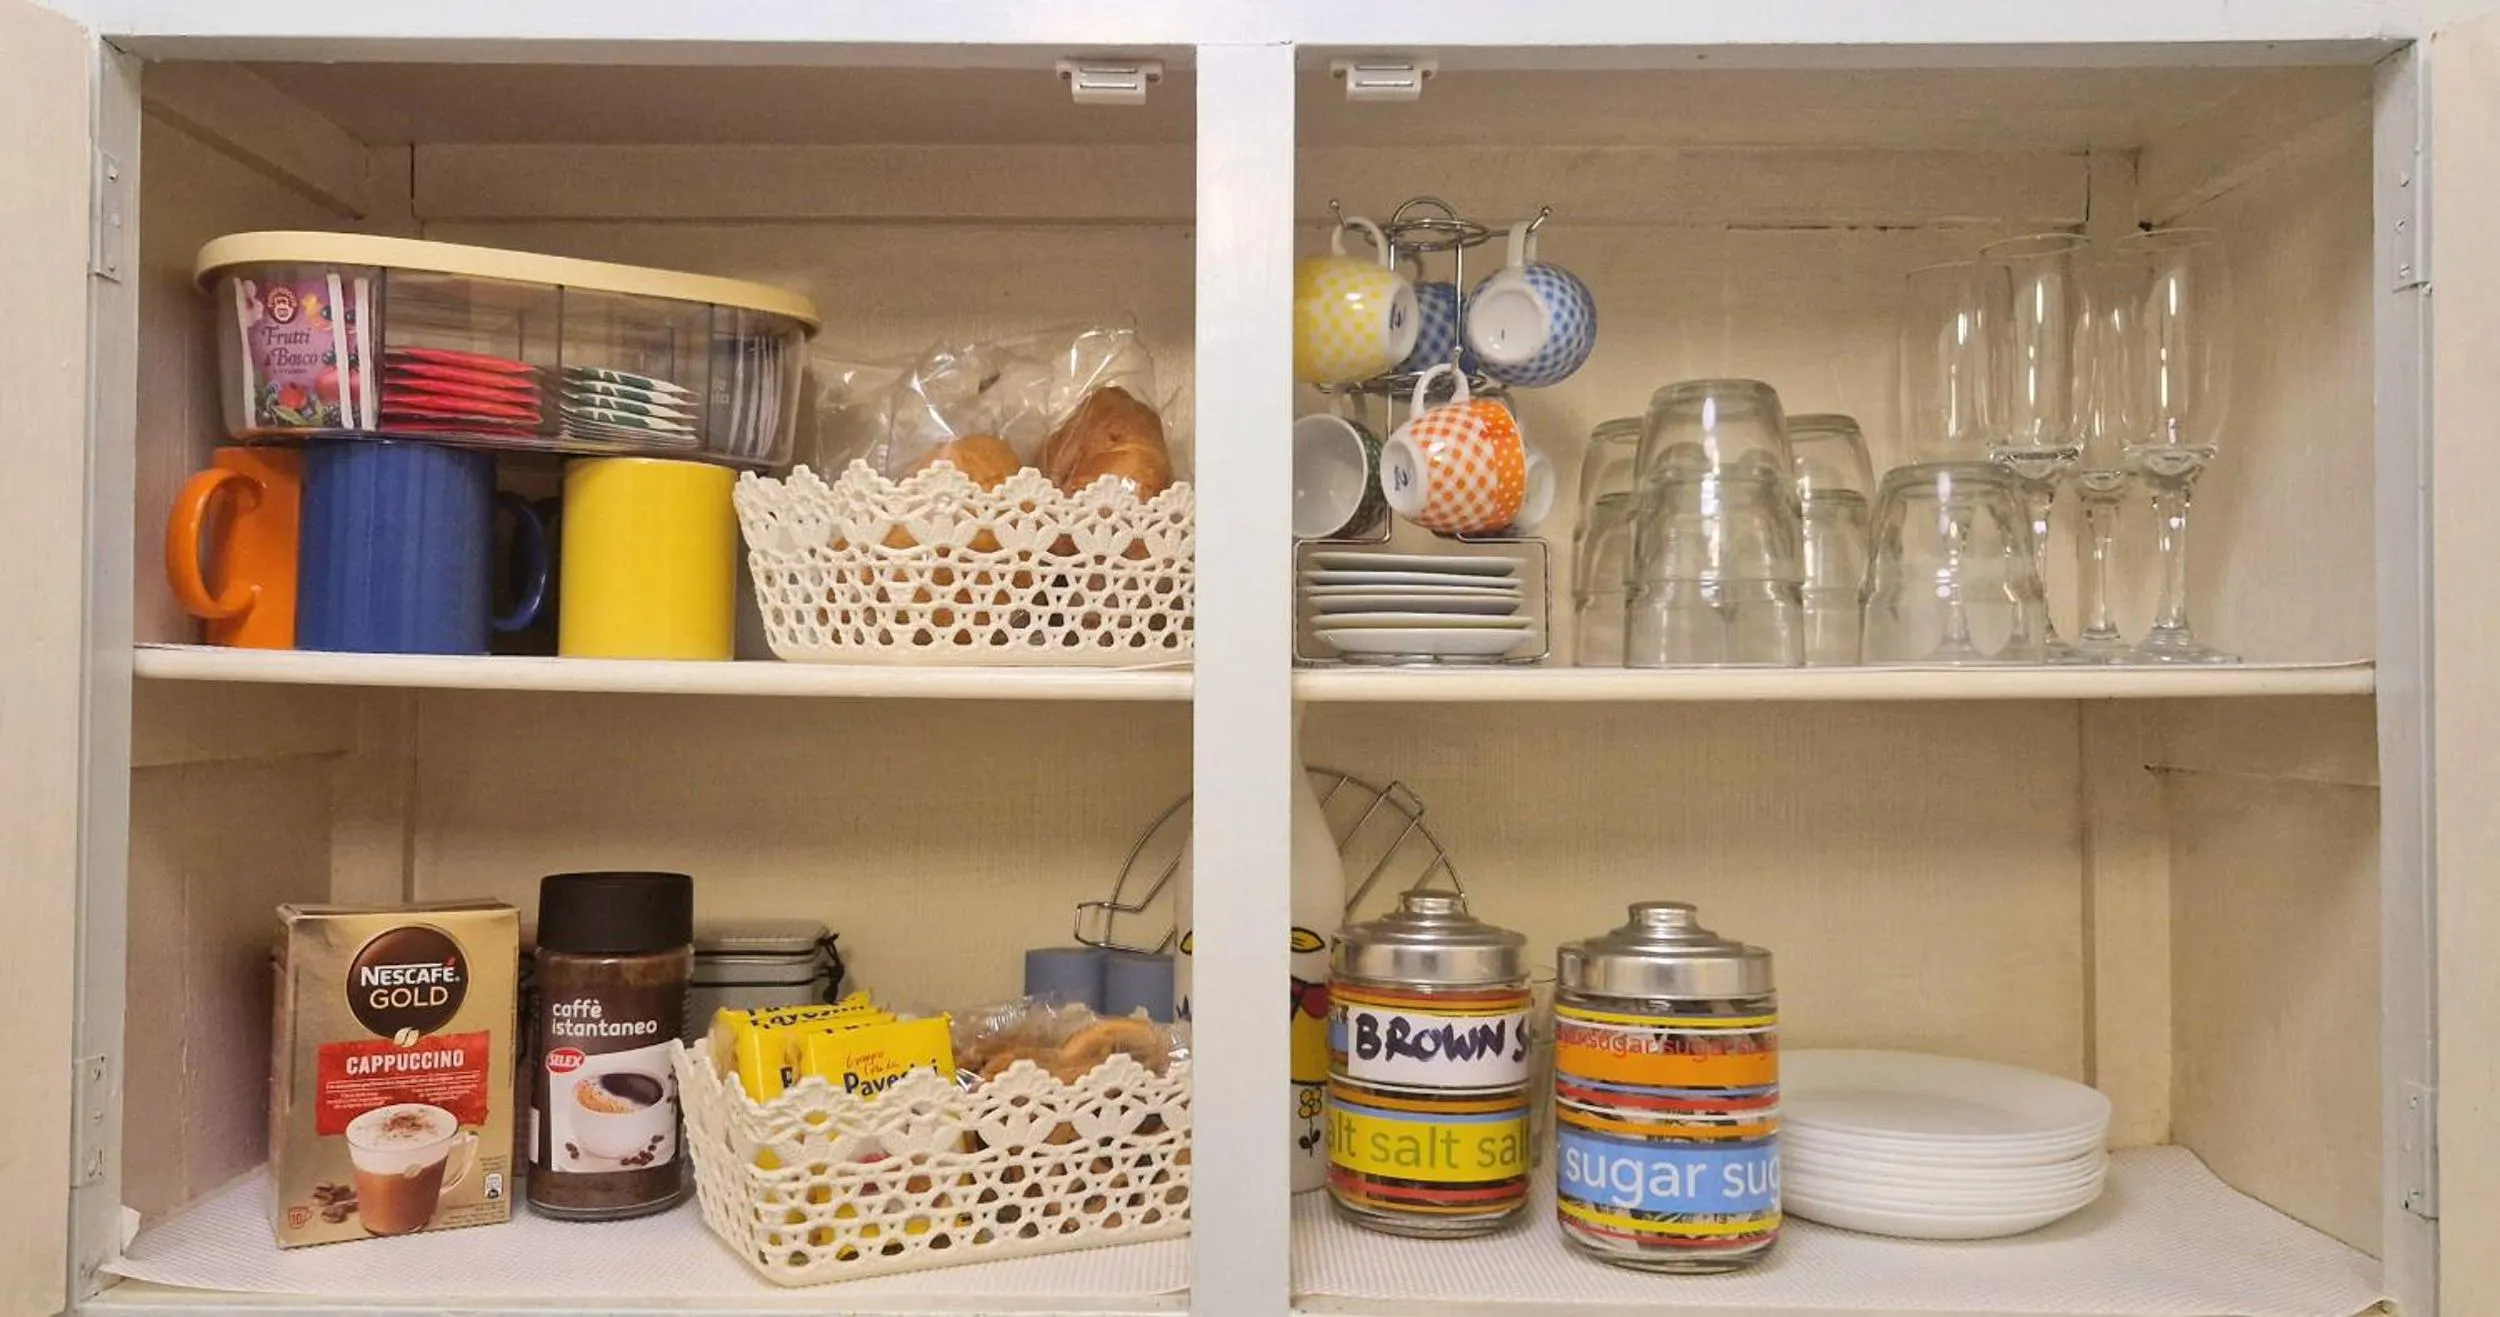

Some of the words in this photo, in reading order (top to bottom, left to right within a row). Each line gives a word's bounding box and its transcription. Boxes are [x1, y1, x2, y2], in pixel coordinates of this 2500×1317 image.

[261, 325, 312, 345] Frutti
[268, 346, 319, 367] Bosco
[360, 957, 456, 987] NESCAFÉ
[369, 986, 450, 1010] GOLD
[552, 999, 603, 1019] caffè
[551, 1018, 658, 1038] istantaneo
[1355, 1012, 1506, 1063] BROWN
[345, 1050, 465, 1076] CAPPUCCINO
[842, 1058, 940, 1096] Pavei
[1369, 1126, 1461, 1169] salt
[1565, 1147, 1707, 1208] sugar
